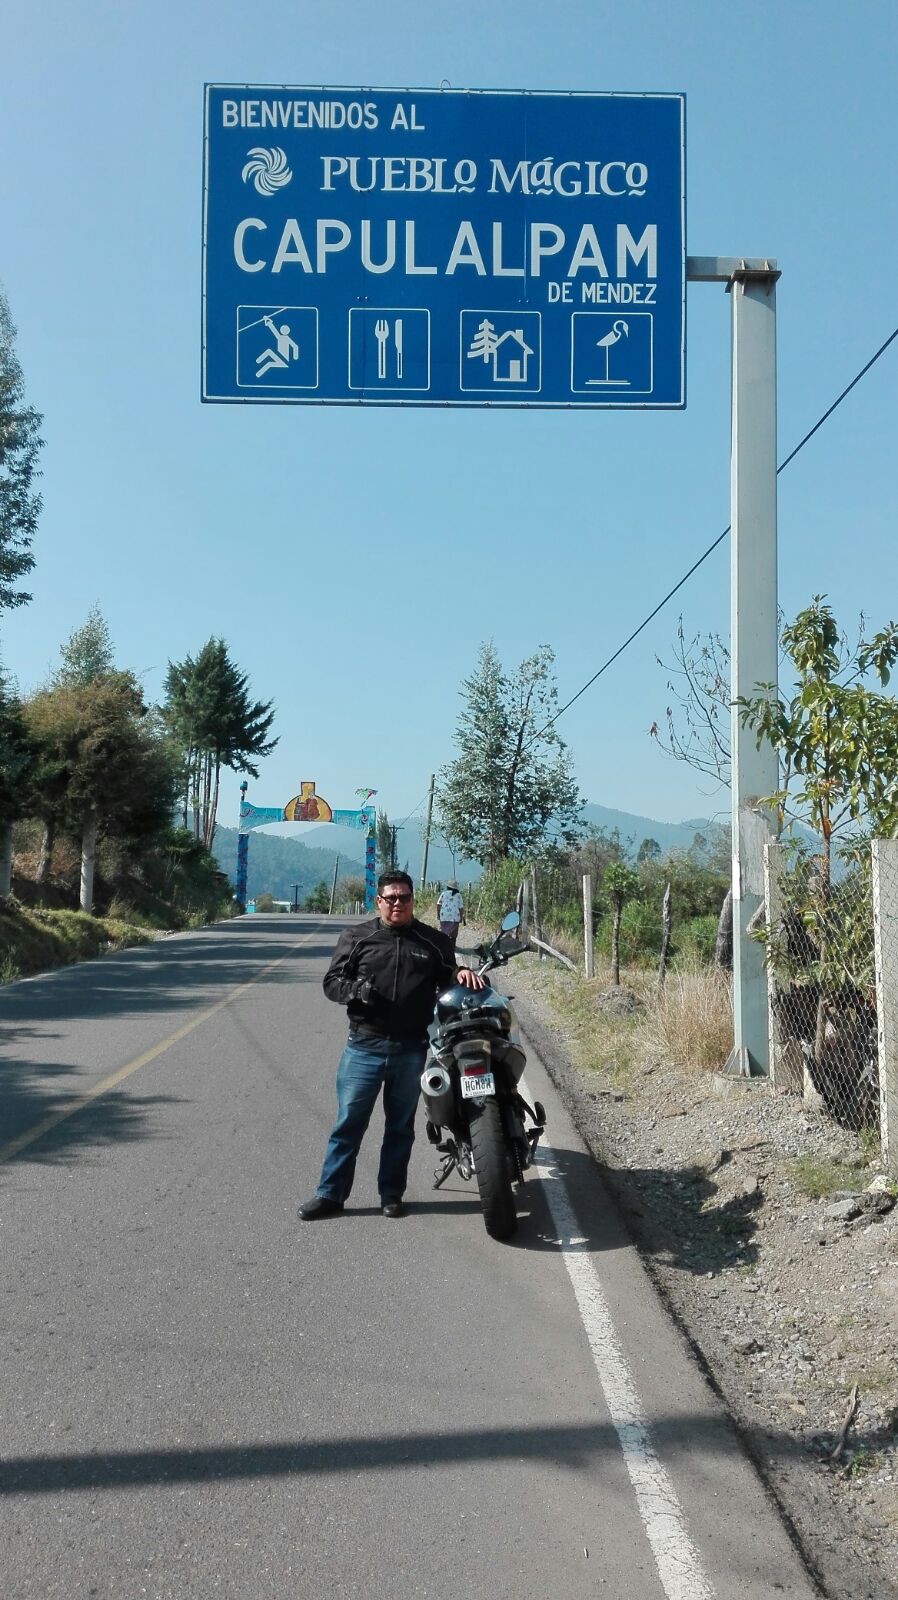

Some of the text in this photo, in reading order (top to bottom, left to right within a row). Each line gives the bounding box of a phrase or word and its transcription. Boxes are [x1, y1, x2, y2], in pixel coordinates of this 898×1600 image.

[222, 101, 425, 131] BIENVENIDOS AL
[233, 217, 658, 279] CAPULALPAM
[548, 282, 657, 305] DE MENDEZ
